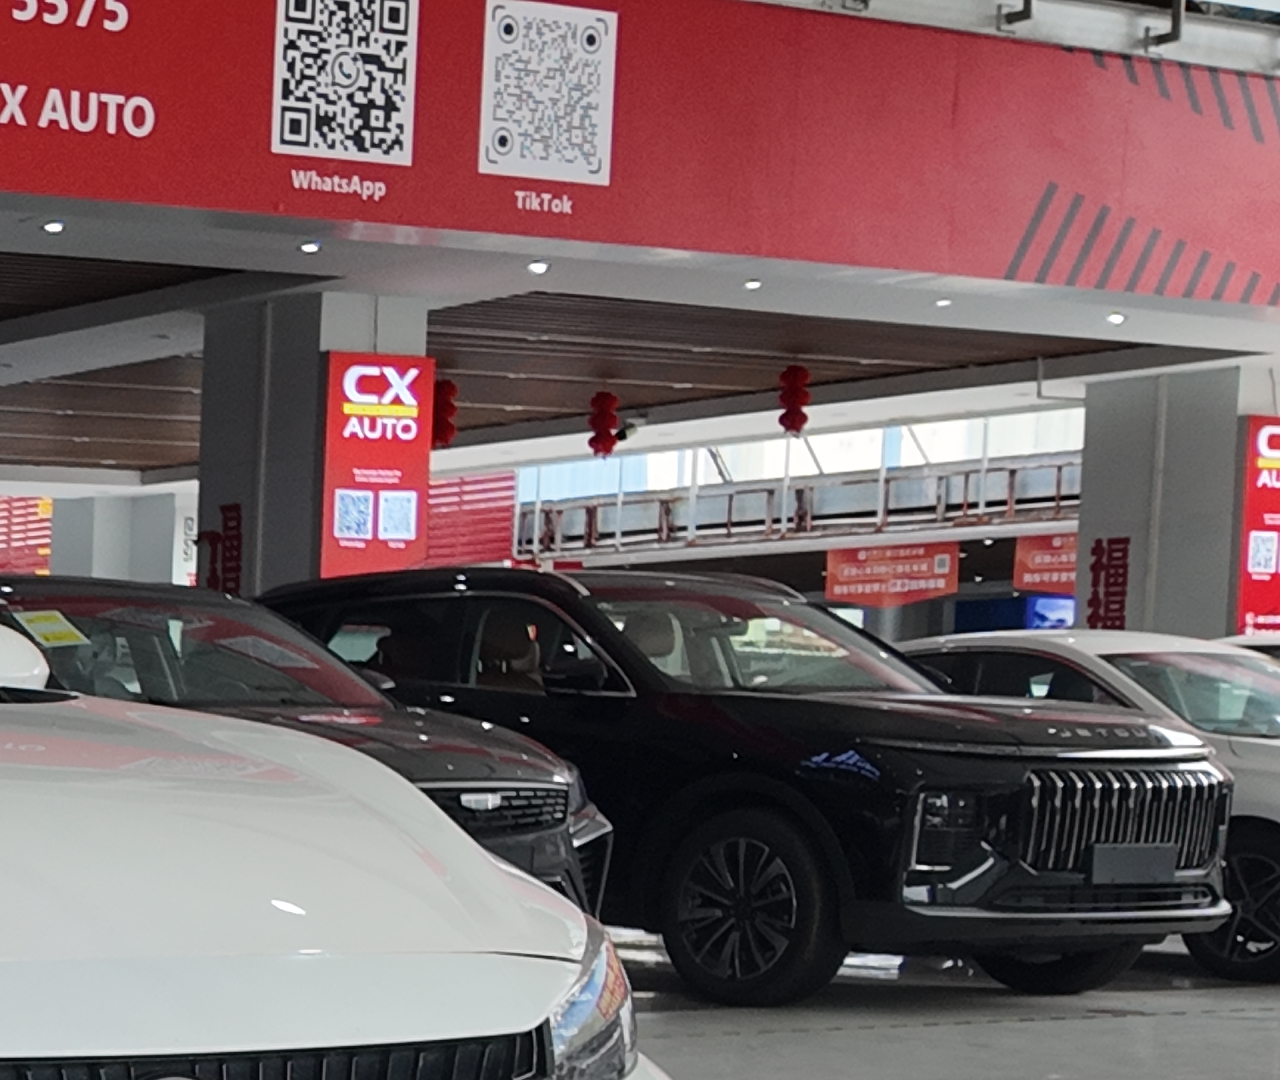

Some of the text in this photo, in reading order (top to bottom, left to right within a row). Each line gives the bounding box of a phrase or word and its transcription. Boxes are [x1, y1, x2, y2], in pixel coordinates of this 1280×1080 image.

[38, 88, 155, 138] AUTO
[291, 169, 387, 201] WhatsApp
[514, 190, 573, 215] TikTok
[342, 364, 420, 406] CX
[342, 416, 419, 441] AUTO
[1256, 424, 1280, 459] C
